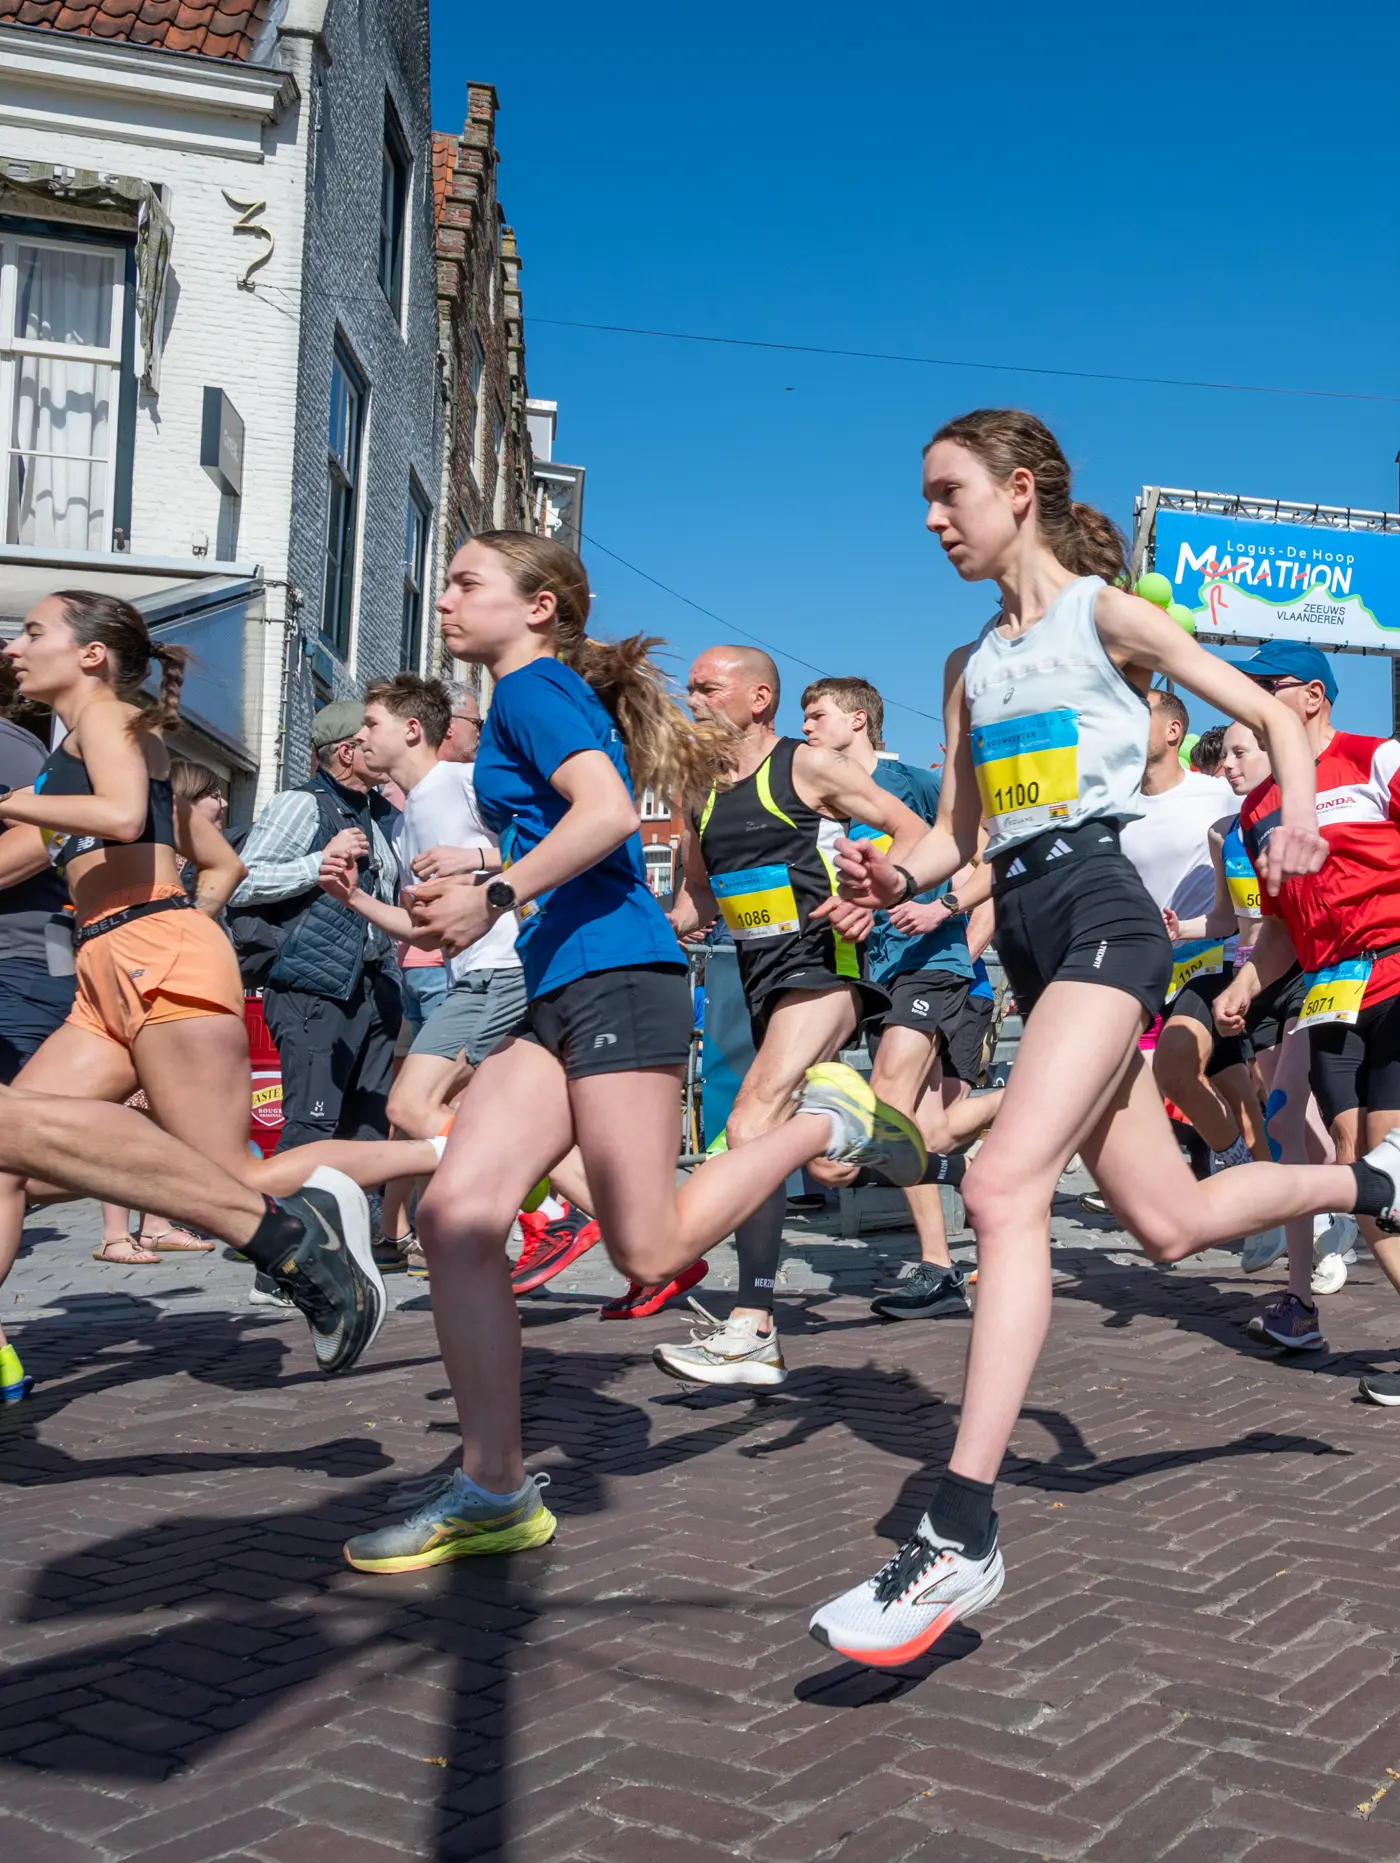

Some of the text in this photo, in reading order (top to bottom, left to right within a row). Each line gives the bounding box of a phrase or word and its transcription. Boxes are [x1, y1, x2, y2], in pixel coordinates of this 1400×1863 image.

[1227, 540, 1354, 564] Logus-De Hoop
[1174, 541, 1353, 594] MARATHON
[1303, 603, 1346, 615] ZEEUWS
[1277, 611, 1345, 625] VLAANDEREN
[994, 781, 1039, 811] 1100
[1315, 796, 1357, 811] ONDA
[1246, 893, 1261, 907] 50
[737, 909, 771, 928] 1086
[1306, 996, 1335, 1016] 5071
[754, 1277, 775, 1288] HERZO
